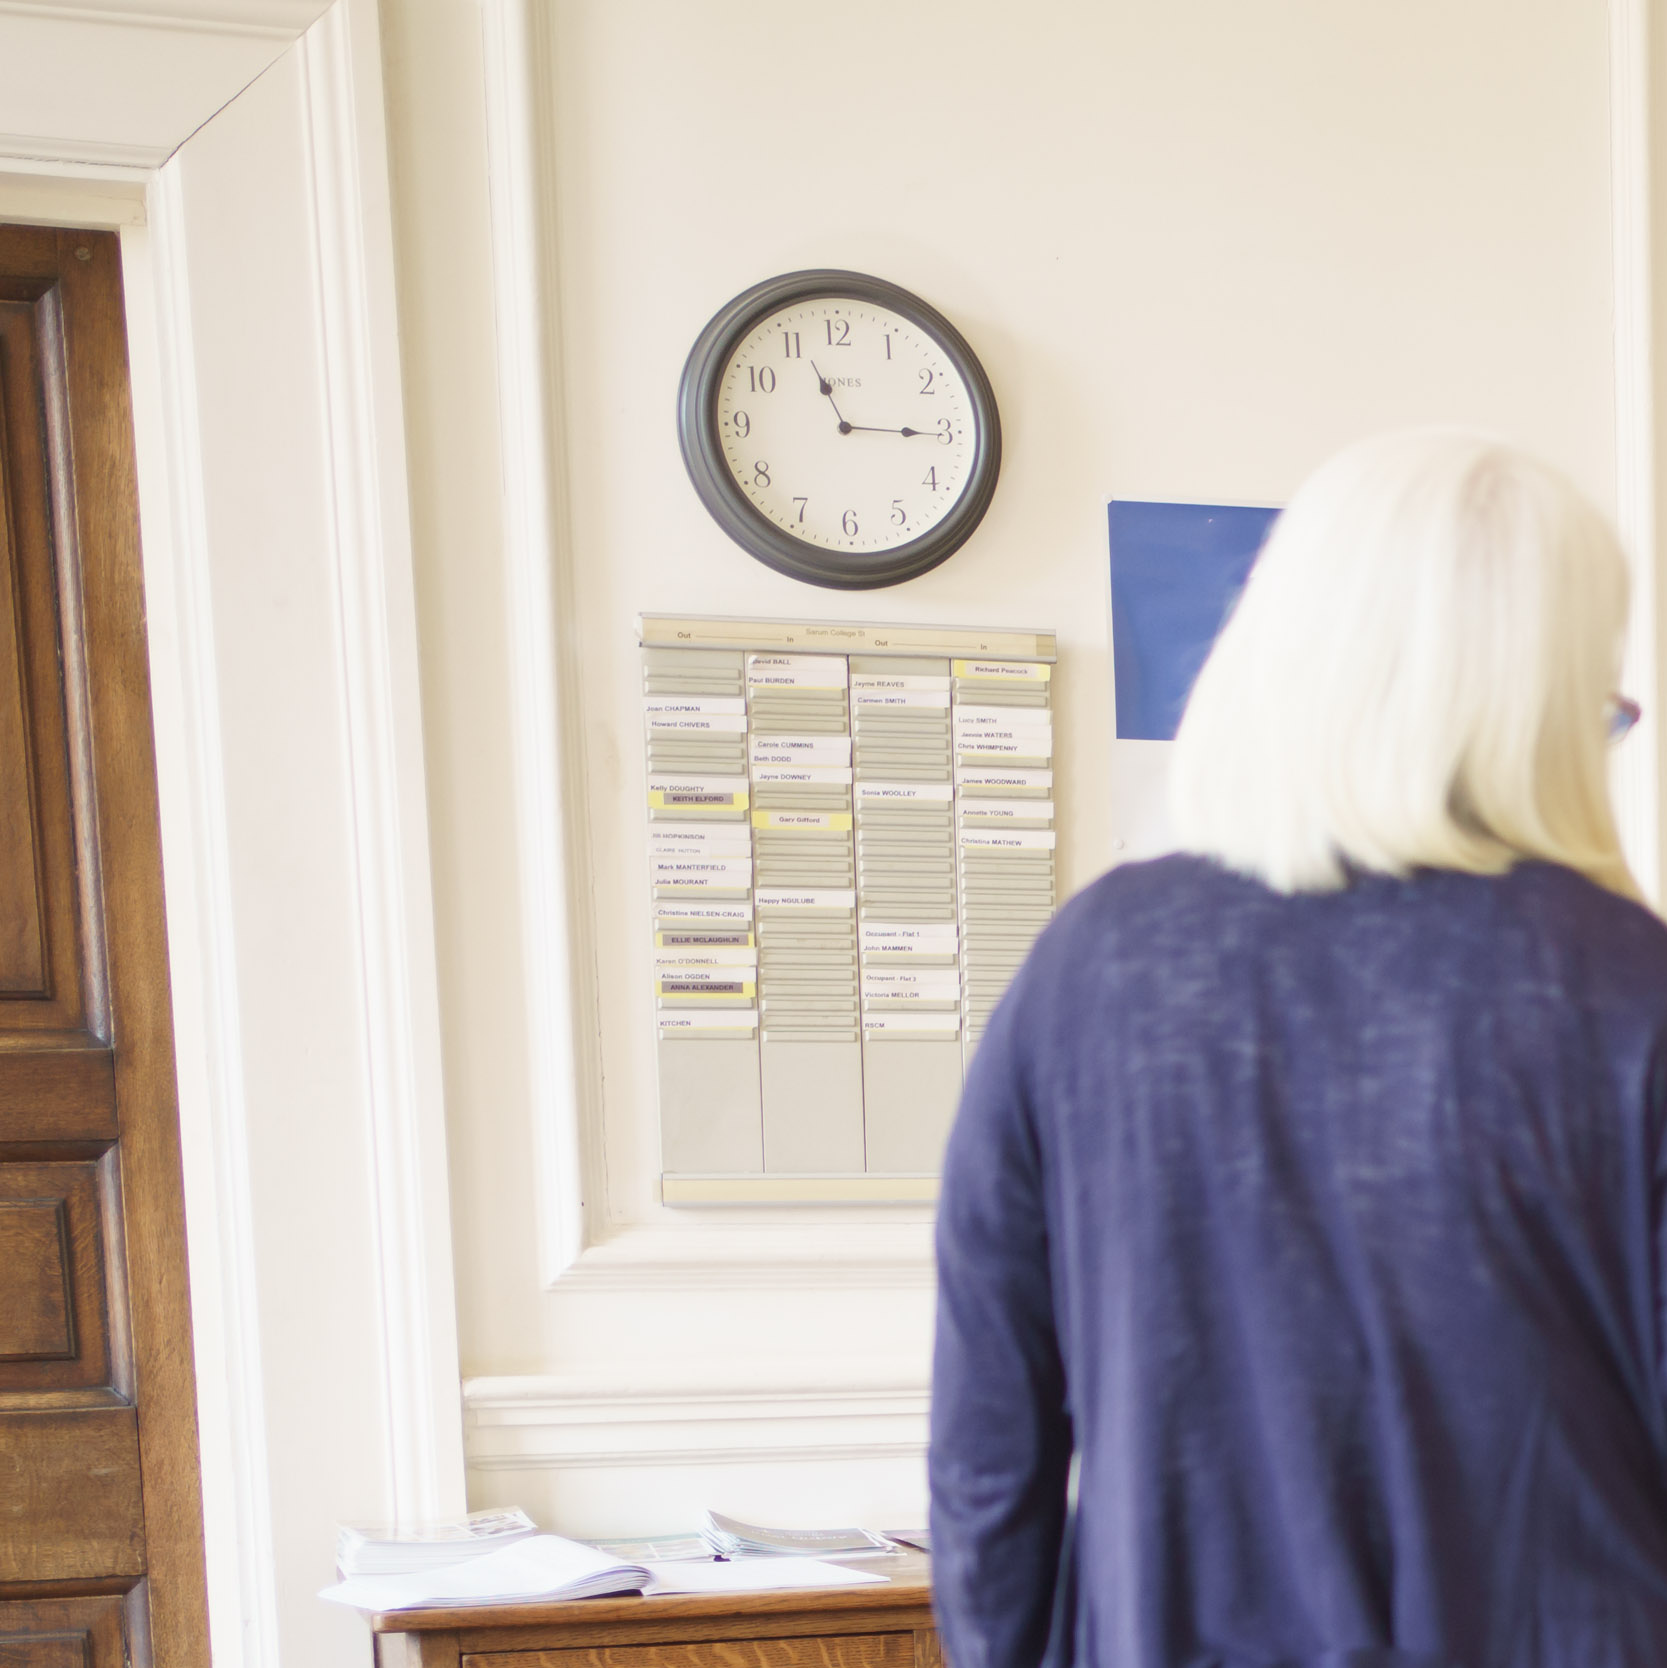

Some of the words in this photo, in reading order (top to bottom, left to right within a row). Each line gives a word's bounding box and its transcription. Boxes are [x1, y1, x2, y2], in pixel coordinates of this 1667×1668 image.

[782, 331, 802, 358] 11
[824, 319, 852, 346] 12
[883, 334, 893, 360] 1
[747, 365, 776, 393] 10
[918, 368, 935, 395] 2
[733, 411, 751, 438] 9
[936, 418, 953, 445] 3
[754, 460, 771, 488] 8
[921, 466, 940, 491] 4
[792, 497, 809, 523] 7
[842, 509, 859, 537] 6
[890, 499, 907, 526] 5
[830, 629, 856, 638] College
[874, 639, 888, 647] Out
[962, 777, 982, 785] James
[759, 897, 780, 905] Happy
